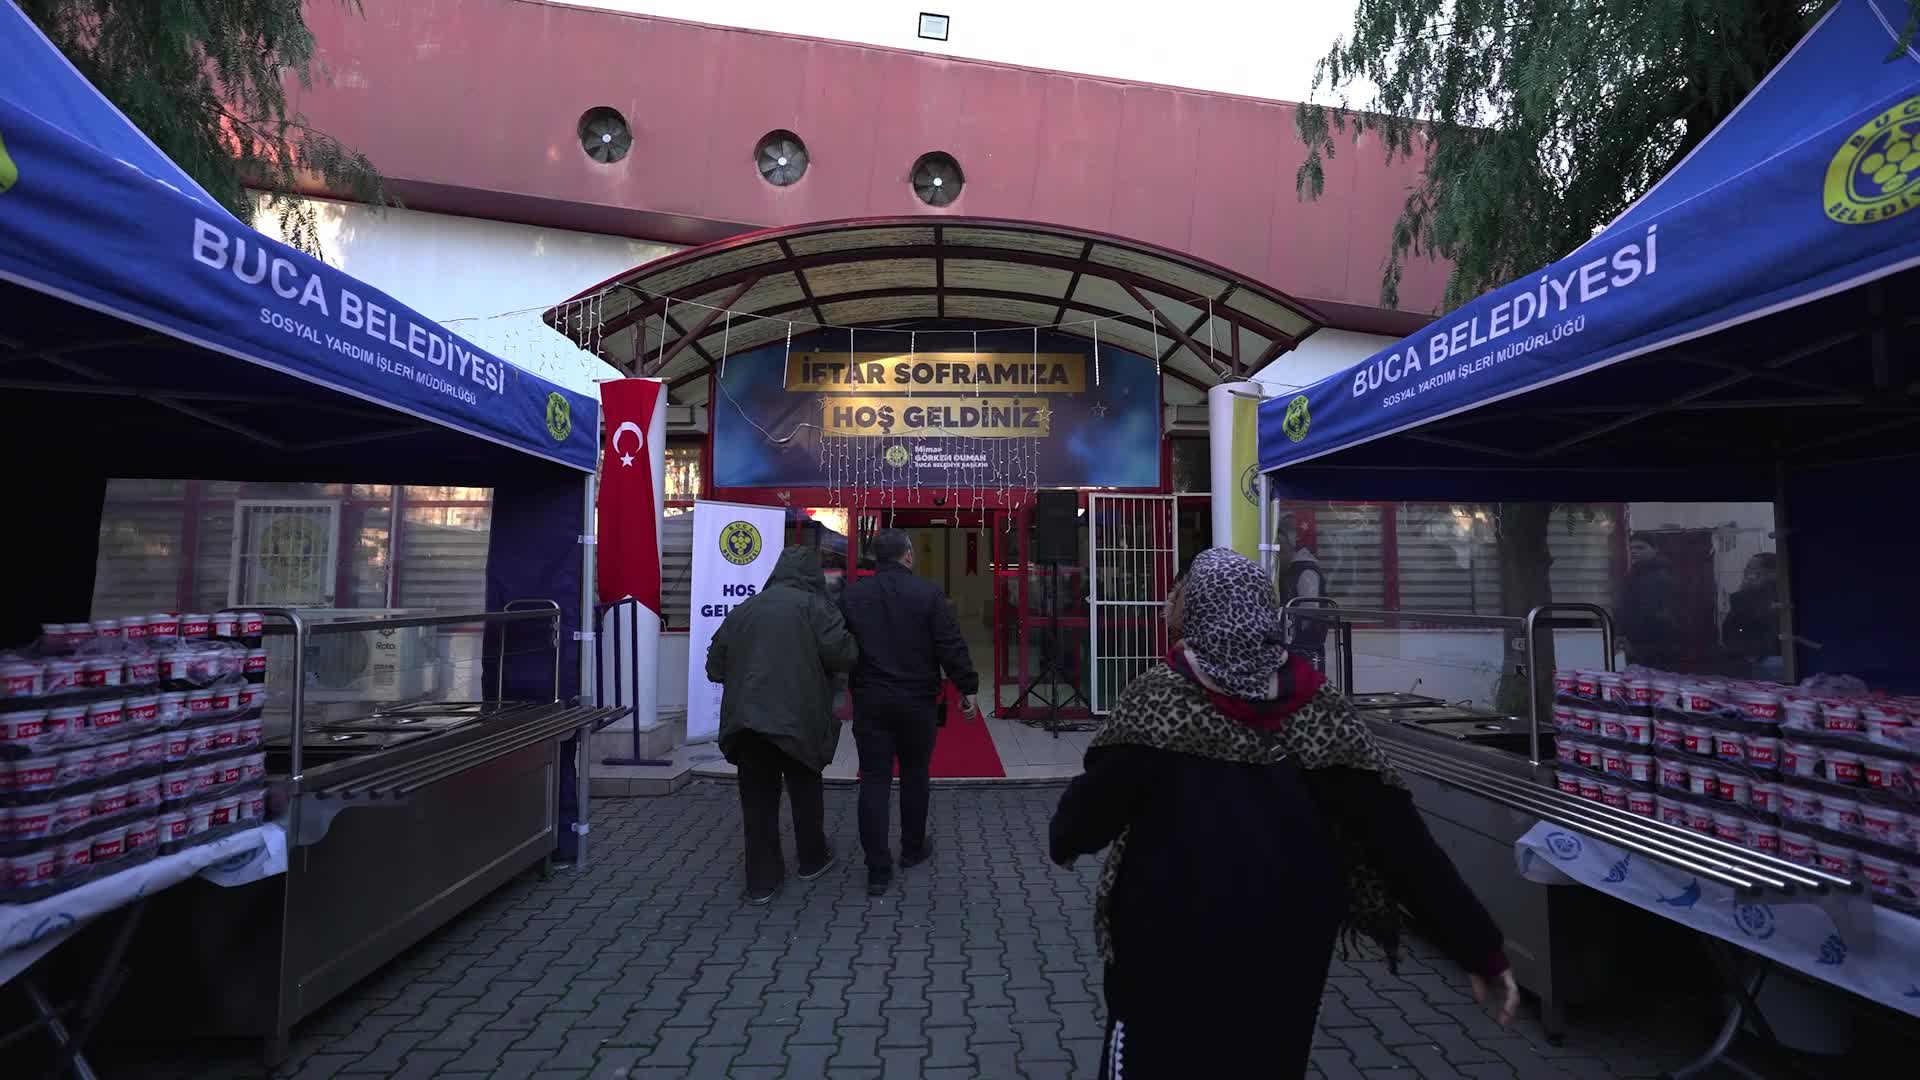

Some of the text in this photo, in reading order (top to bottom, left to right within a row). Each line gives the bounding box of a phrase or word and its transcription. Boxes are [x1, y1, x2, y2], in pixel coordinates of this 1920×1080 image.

[193, 218, 505, 394] BUCA BELEDİYESİ
[1352, 224, 1657, 398] BUCA BELEDİYESİ
[260, 308, 476, 405] SOSYAL YARDIM İŞLERİ MÜDÜRLÜĞÜ
[802, 356, 1069, 384] İFTAR SOFRAMIZA
[1383, 314, 1585, 408] SOSYAL YARDIM İŞLERİ MÜDÜRLÜĞÜ
[833, 400, 1039, 434] HOŞ GELDİNİZ
[915, 453, 952, 462] GÖRKEM
[729, 523, 754, 531] BUCA
